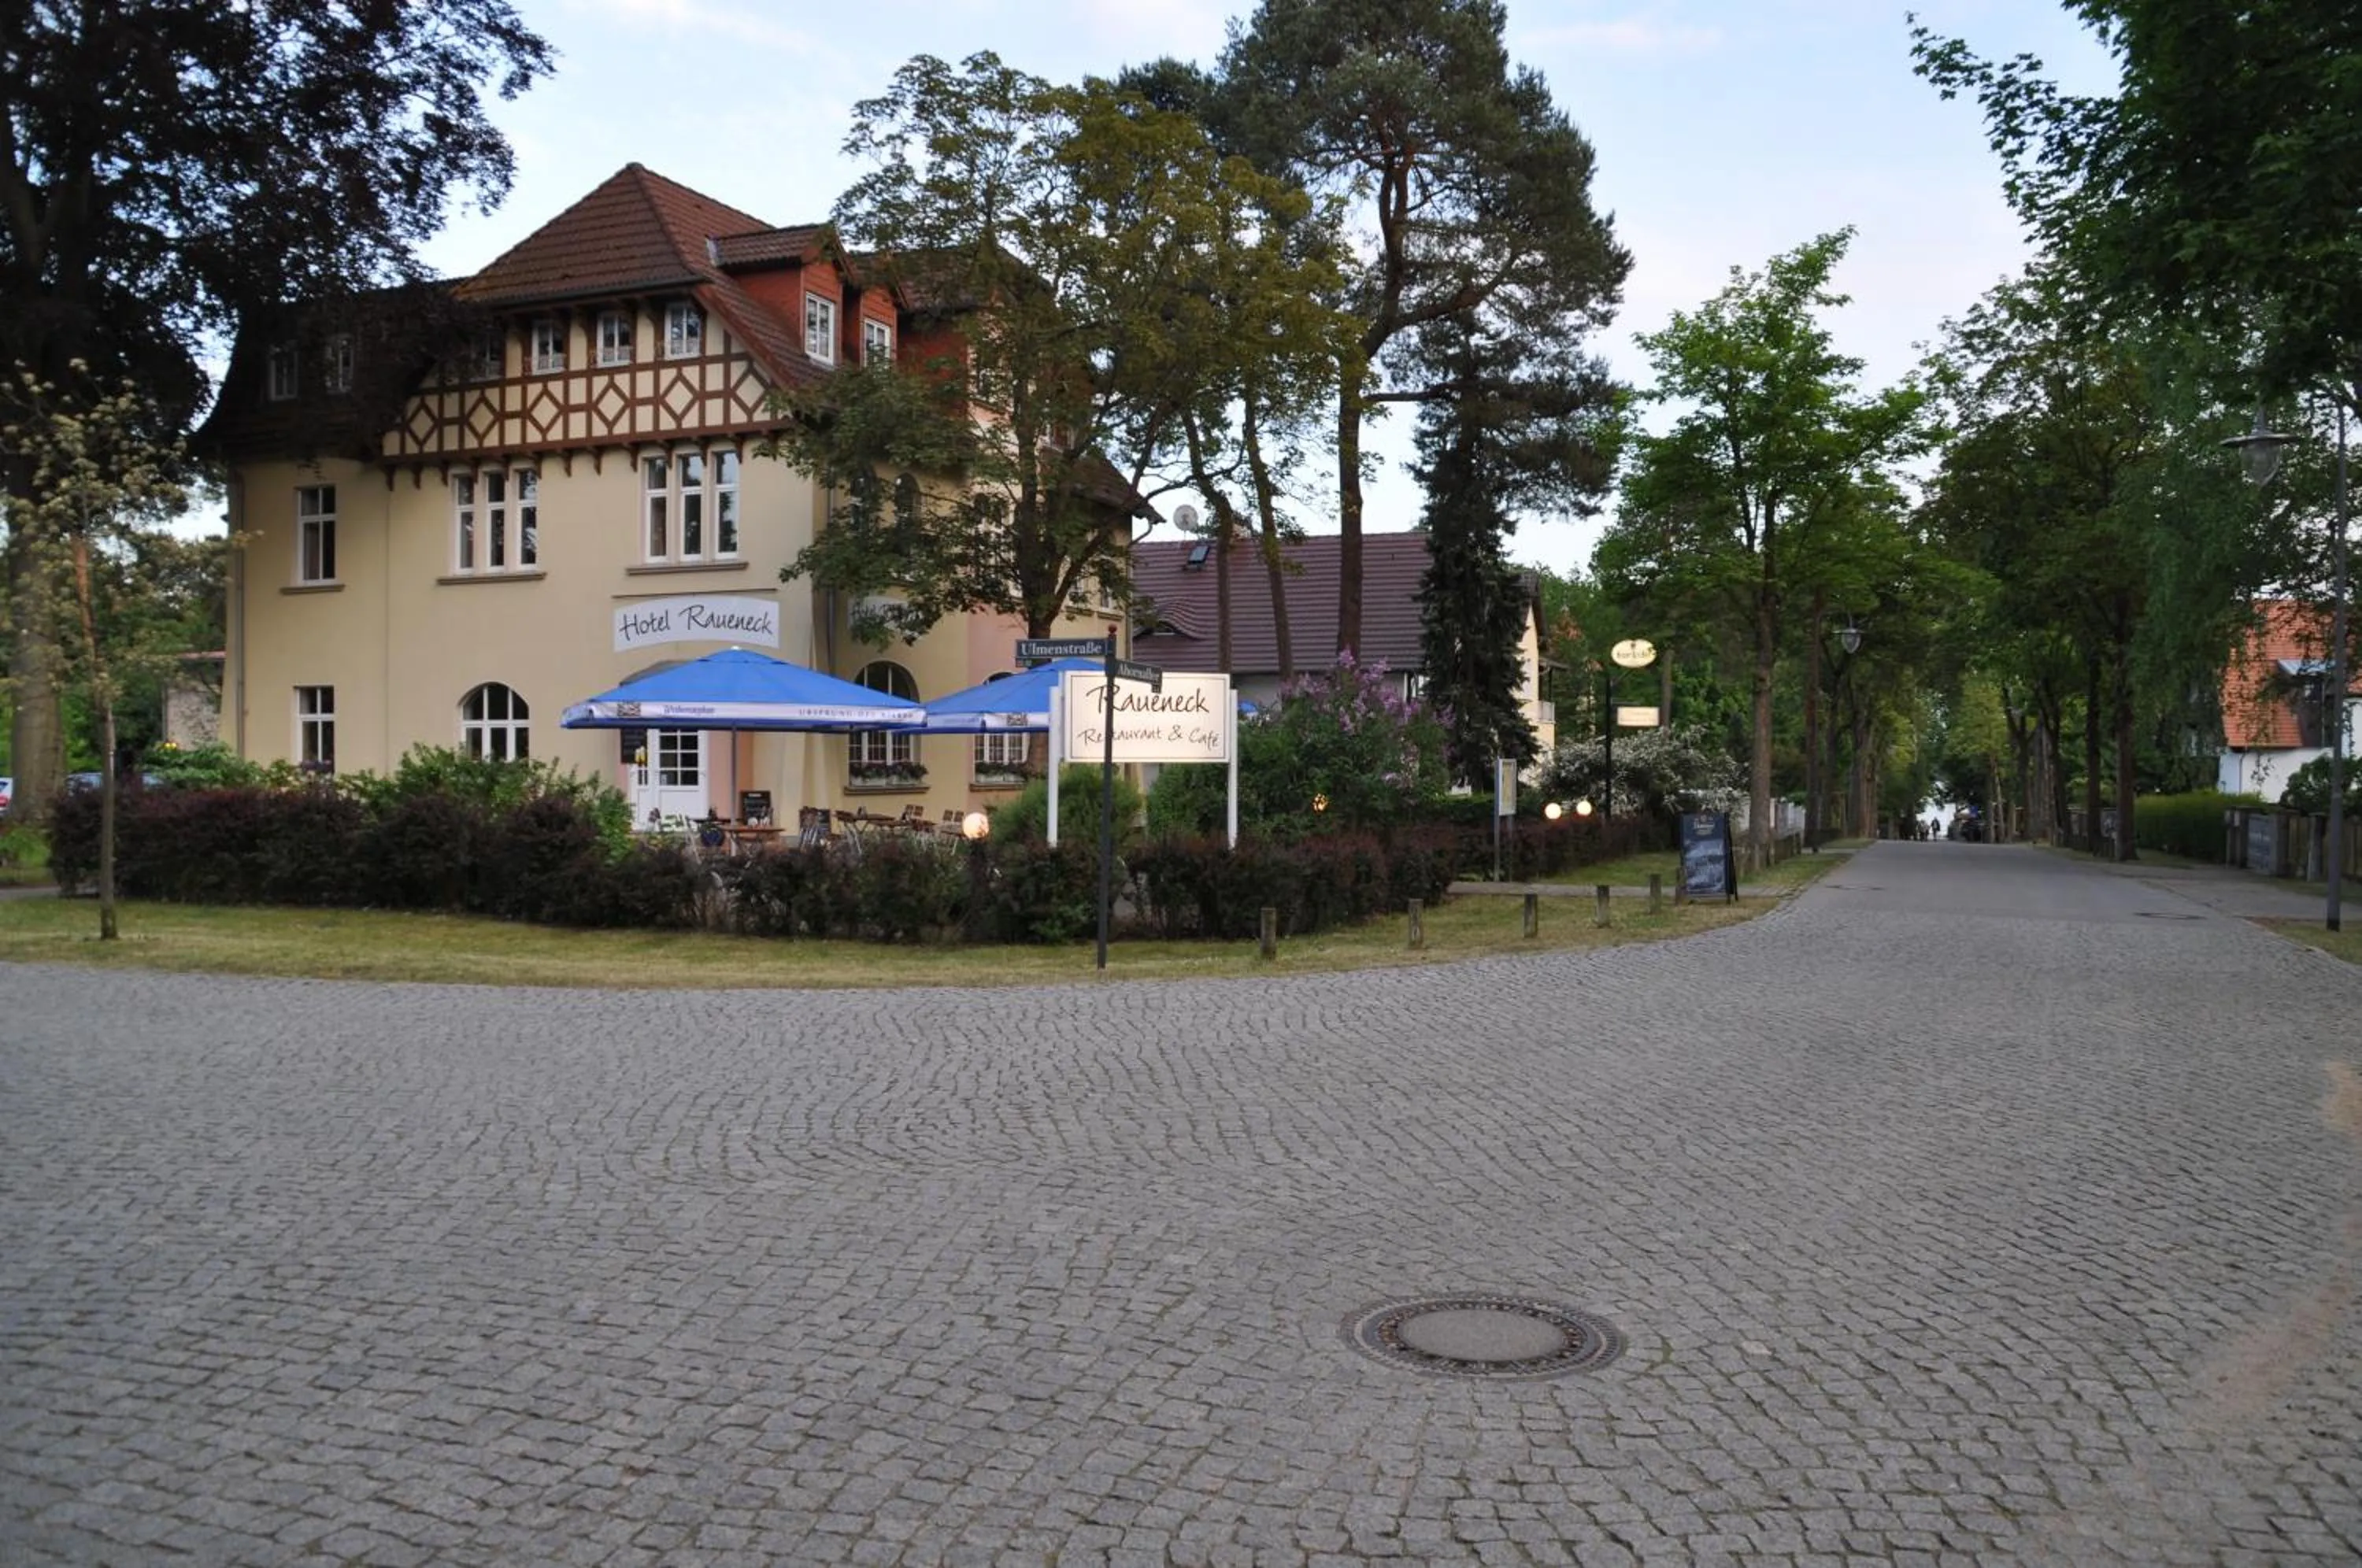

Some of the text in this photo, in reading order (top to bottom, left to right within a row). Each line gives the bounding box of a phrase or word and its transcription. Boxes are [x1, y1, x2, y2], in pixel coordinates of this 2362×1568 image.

[619, 604, 772, 641] Hotel Raueneck
[1020, 641, 1102, 656] Ulmenstraße
[1086, 684, 1210, 714] Raueneck
[1077, 723, 1220, 752] Retaurant & Café
